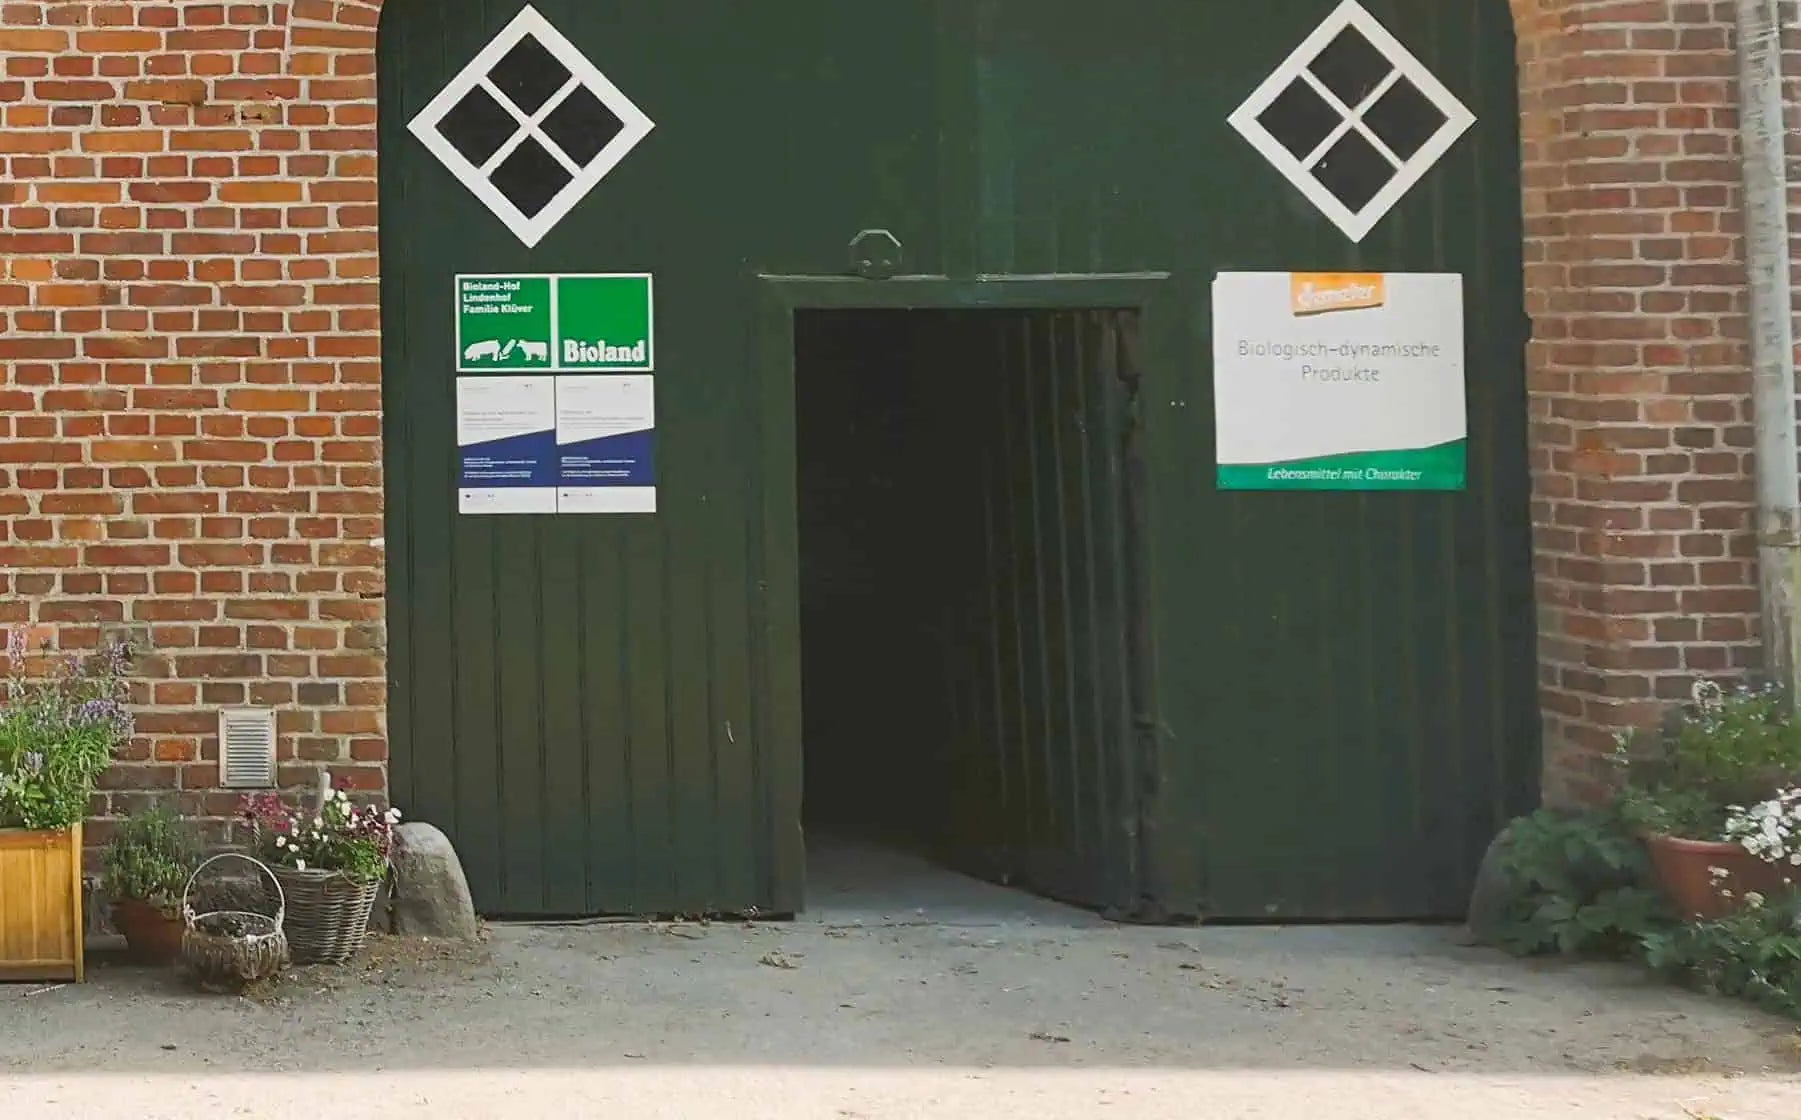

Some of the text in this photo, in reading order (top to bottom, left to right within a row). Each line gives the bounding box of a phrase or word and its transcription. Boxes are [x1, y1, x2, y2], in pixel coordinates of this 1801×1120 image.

[462, 281, 521, 292] Bioland-Hof
[462, 292, 512, 303] Lindenhof
[462, 303, 534, 314] Familie Klüver
[563, 339, 646, 363] Bioland
[1237, 339, 1441, 361] Biologisch-dynamische
[1301, 364, 1380, 382] Produkte
[1267, 467, 1342, 480] Lebensmittel
[1343, 468, 1363, 480] mit
